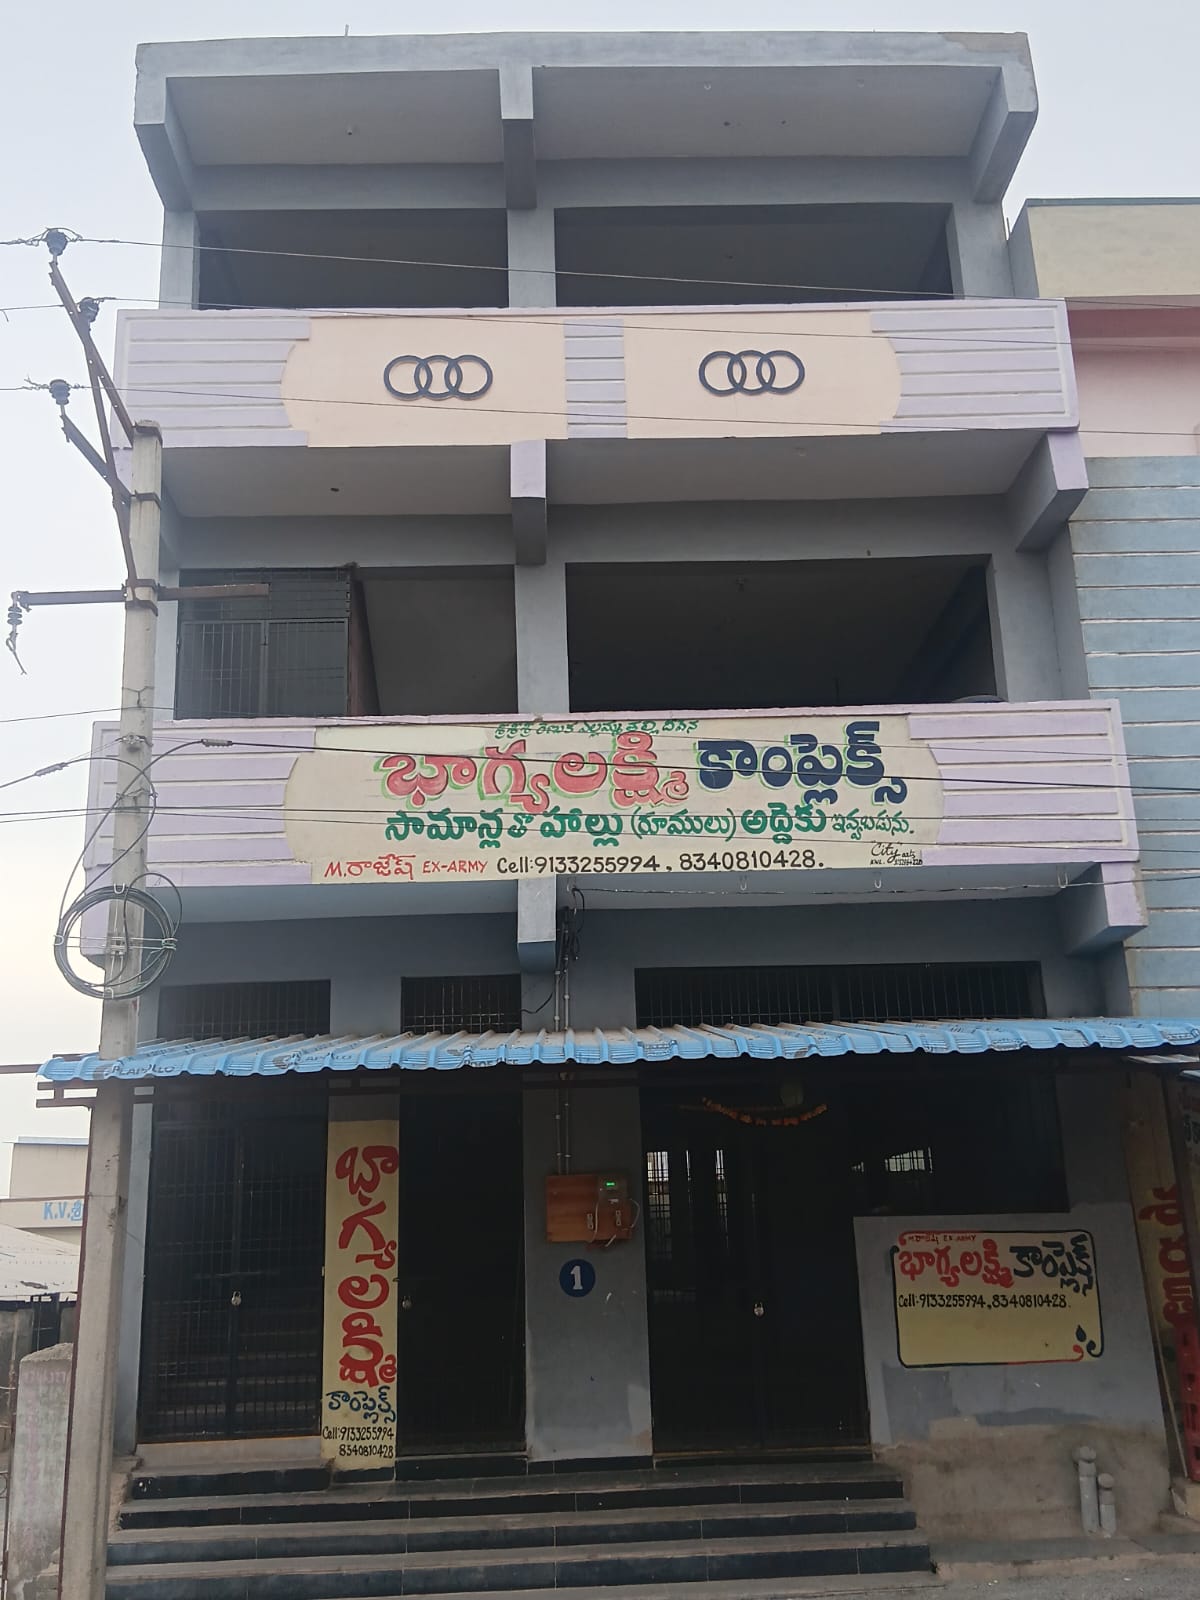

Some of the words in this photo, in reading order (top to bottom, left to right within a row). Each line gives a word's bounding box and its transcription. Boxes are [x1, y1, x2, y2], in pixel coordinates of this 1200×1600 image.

[376, 731, 690, 813] భాగ్యలక్ష్మి
[696, 721, 908, 804] కాంప్లెక్స్
[740, 802, 827, 845] అద్దెకు
[570, 1265, 583, 1290] 1
